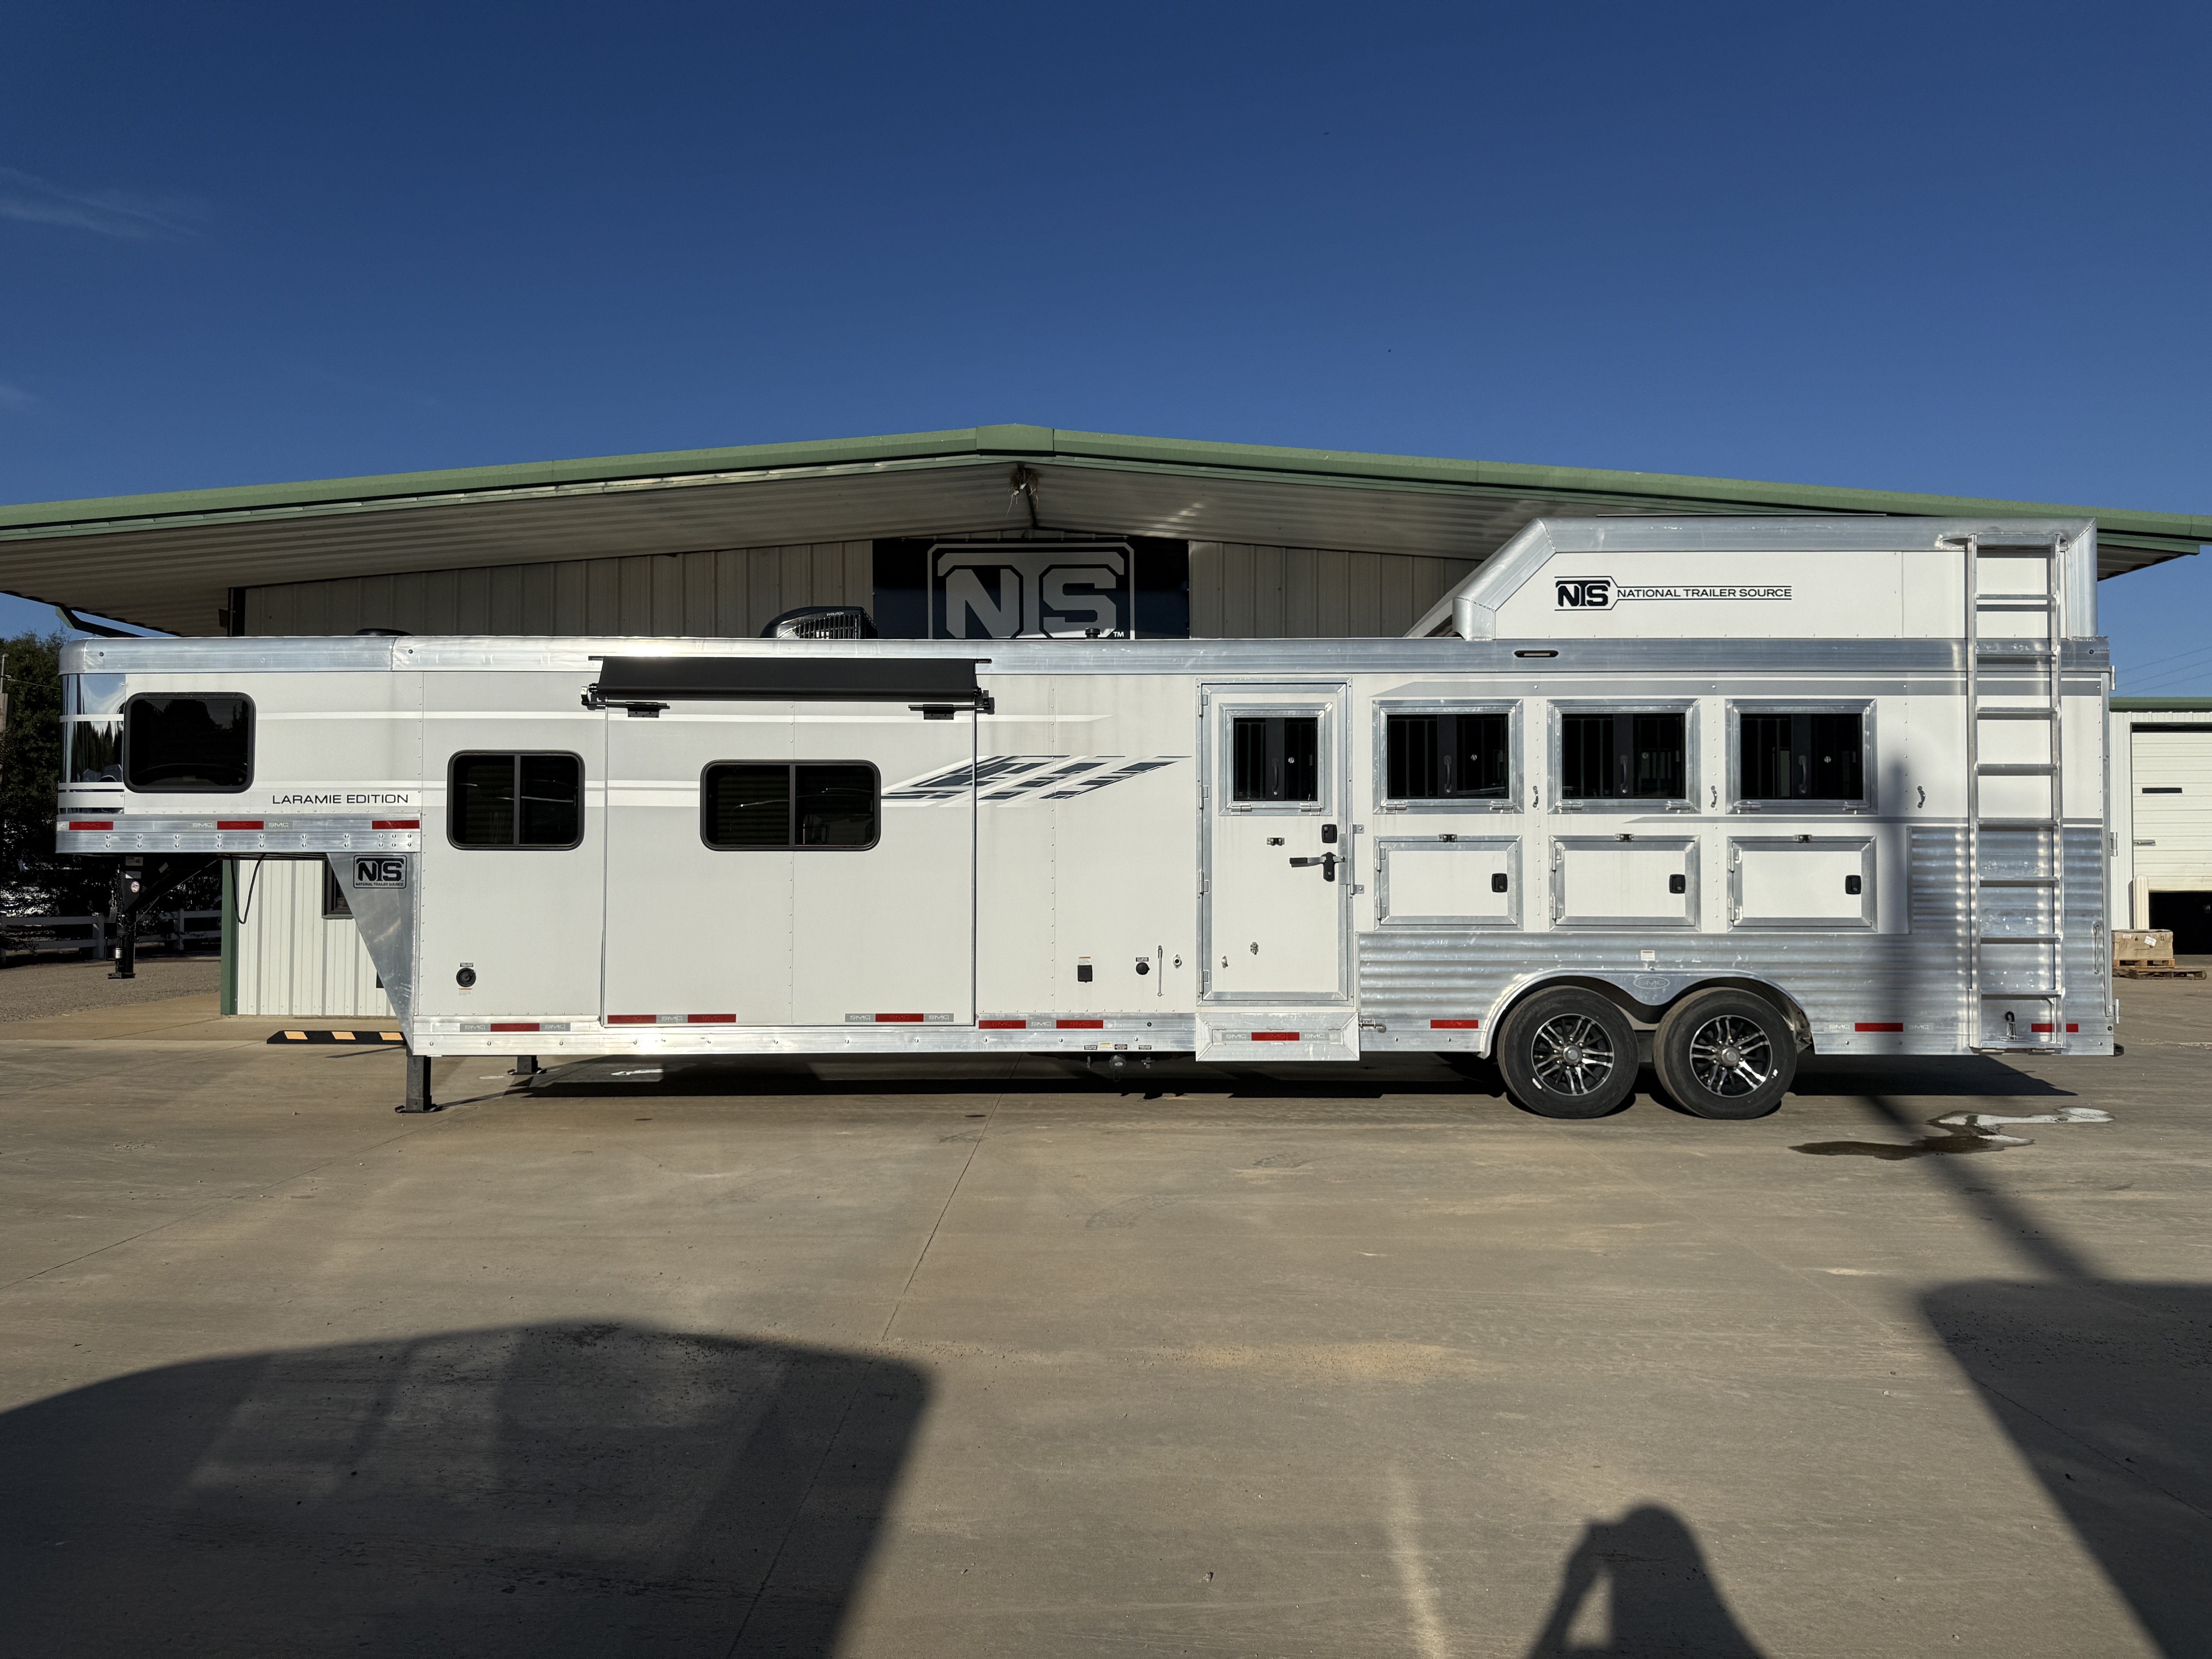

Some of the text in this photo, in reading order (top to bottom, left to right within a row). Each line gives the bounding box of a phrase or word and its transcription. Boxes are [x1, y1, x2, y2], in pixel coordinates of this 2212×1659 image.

[938, 551, 1124, 639] NTS
[1555, 580, 1611, 607] NTS
[1617, 589, 1792, 598] NATIONAL TRAILER SOURCE
[273, 794, 408, 804] LARAMIE EDITION
[356, 858, 404, 881] NTS
